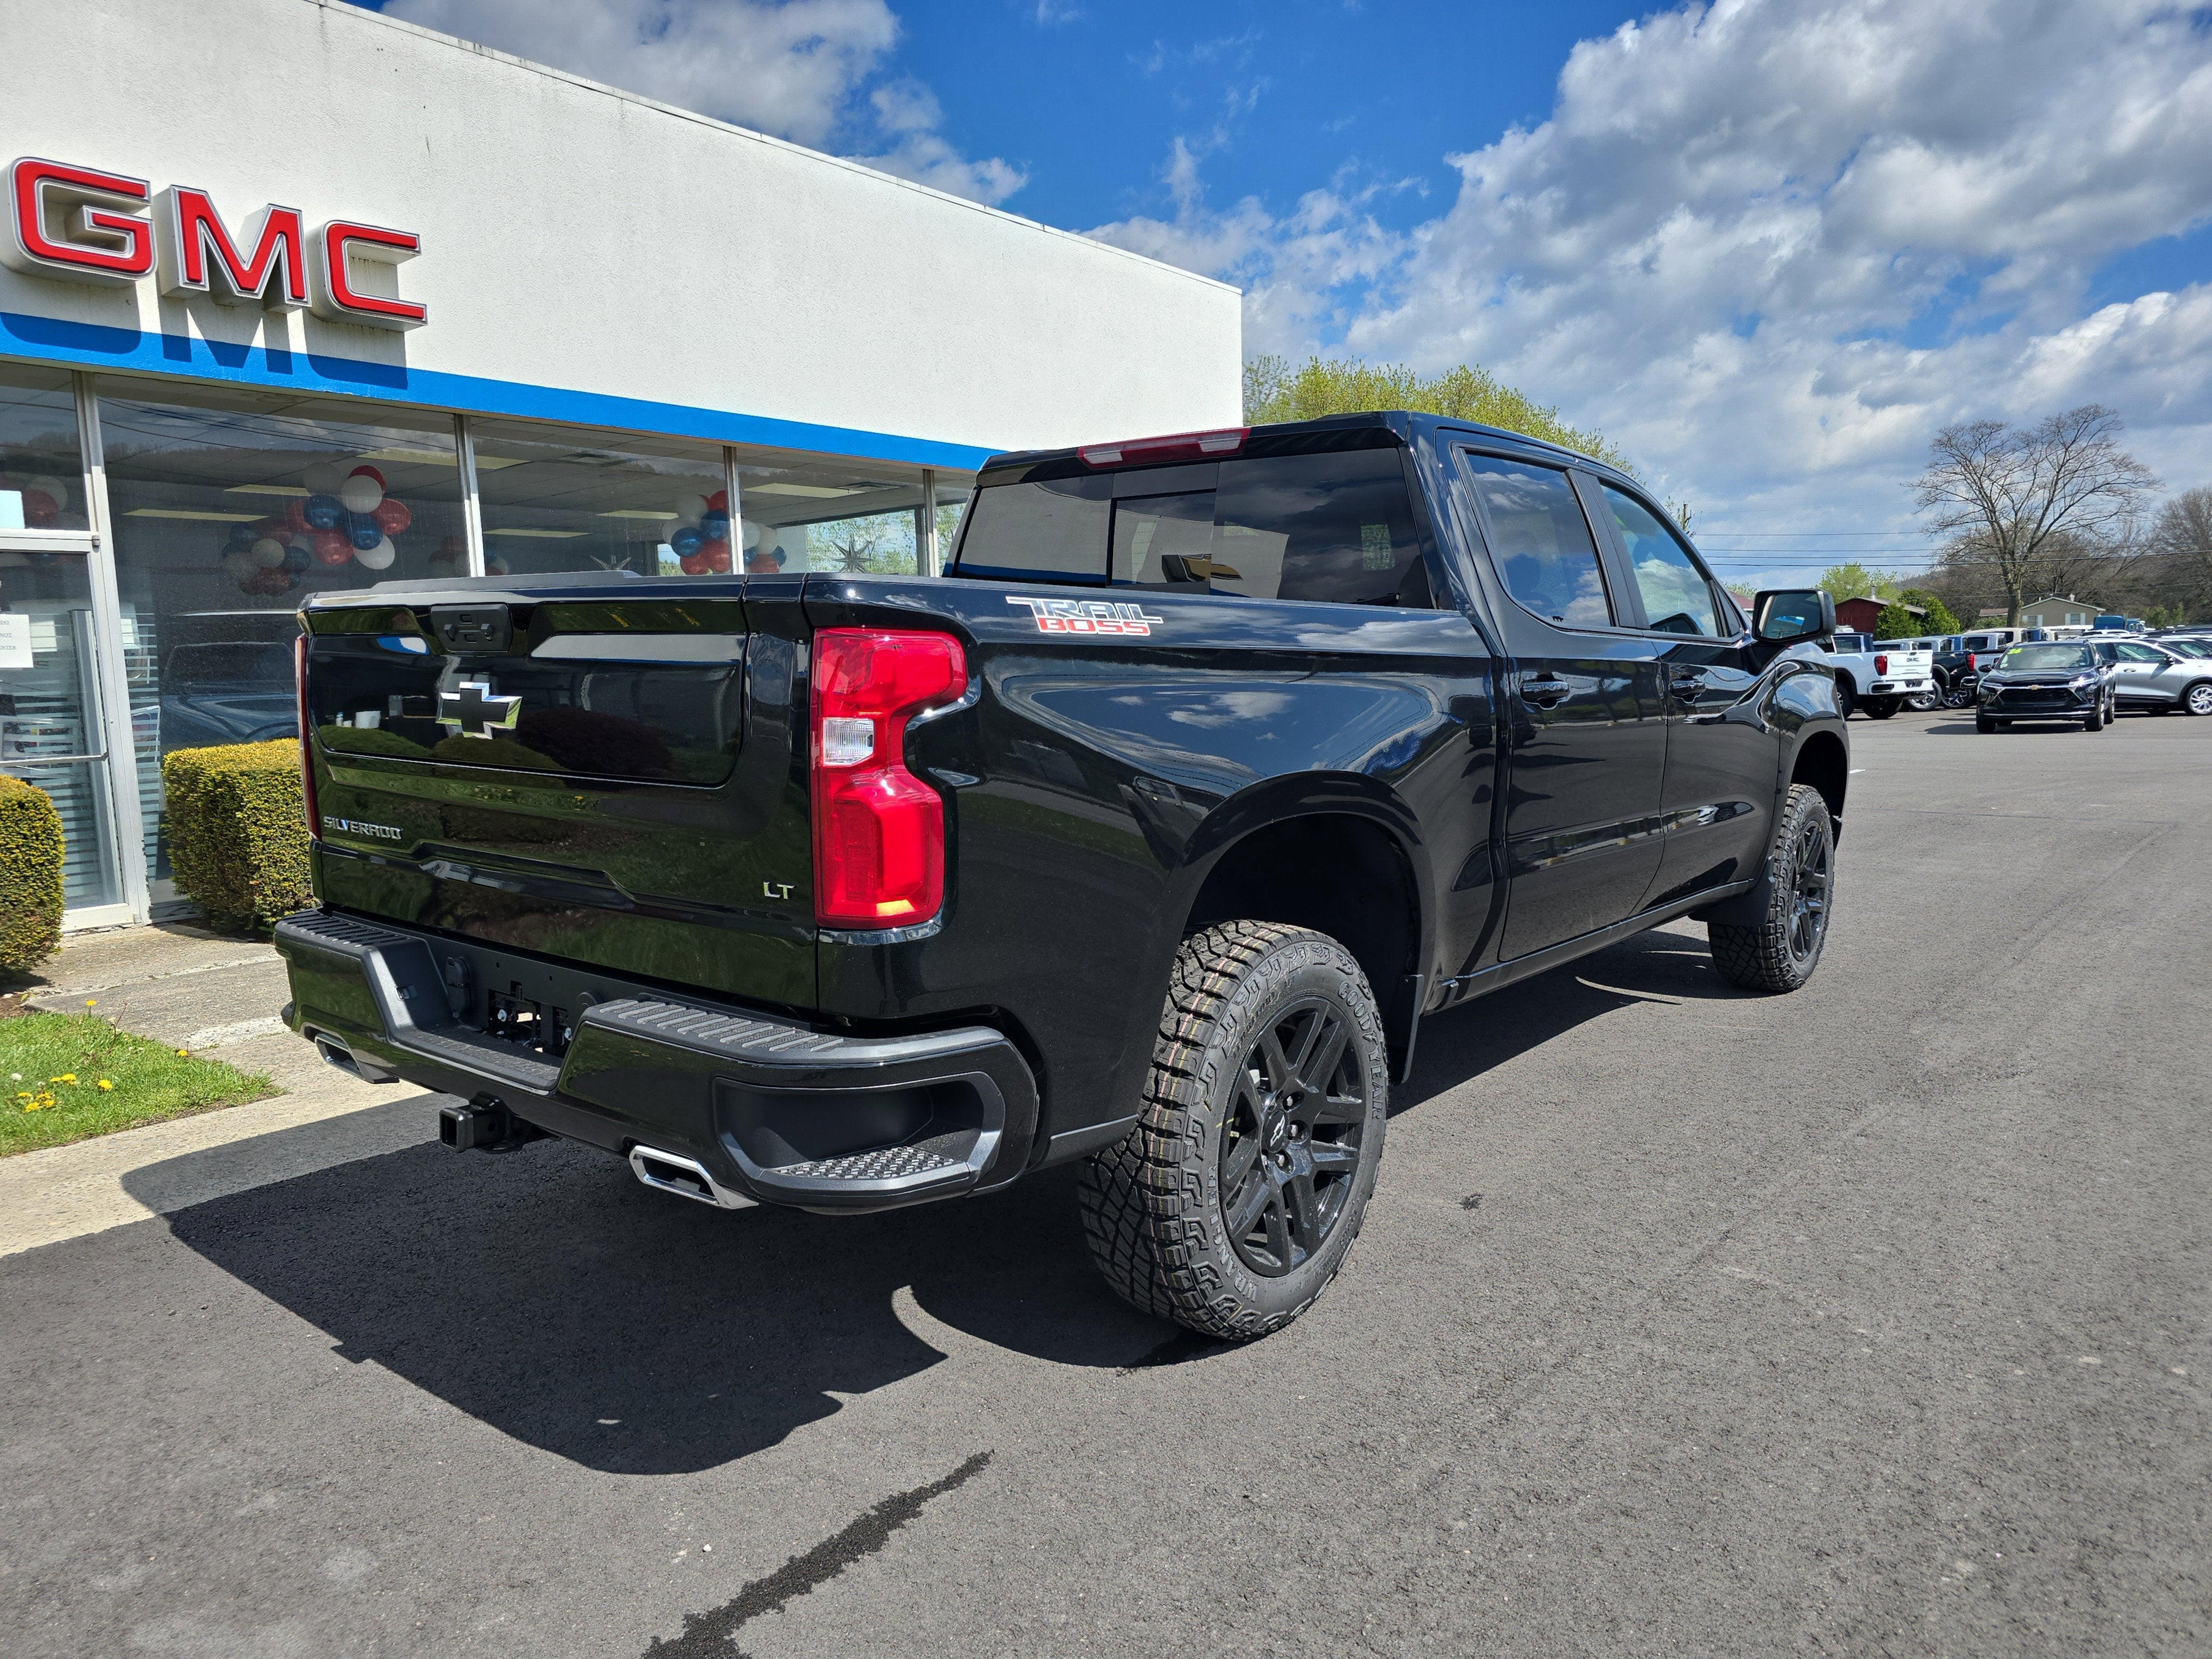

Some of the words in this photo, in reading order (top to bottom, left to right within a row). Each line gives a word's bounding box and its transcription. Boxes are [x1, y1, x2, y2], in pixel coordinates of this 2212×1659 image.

[10, 156, 428, 327] GMC
[1005, 596, 1164, 625] TRAIL
[1036, 616, 1151, 636] BOSS
[323, 816, 403, 840] SILVERADO
[763, 882, 795, 899] LT
[1338, 981, 1383, 1120] GOODYEAR
[1207, 1166, 1258, 1303] WRANGLER
